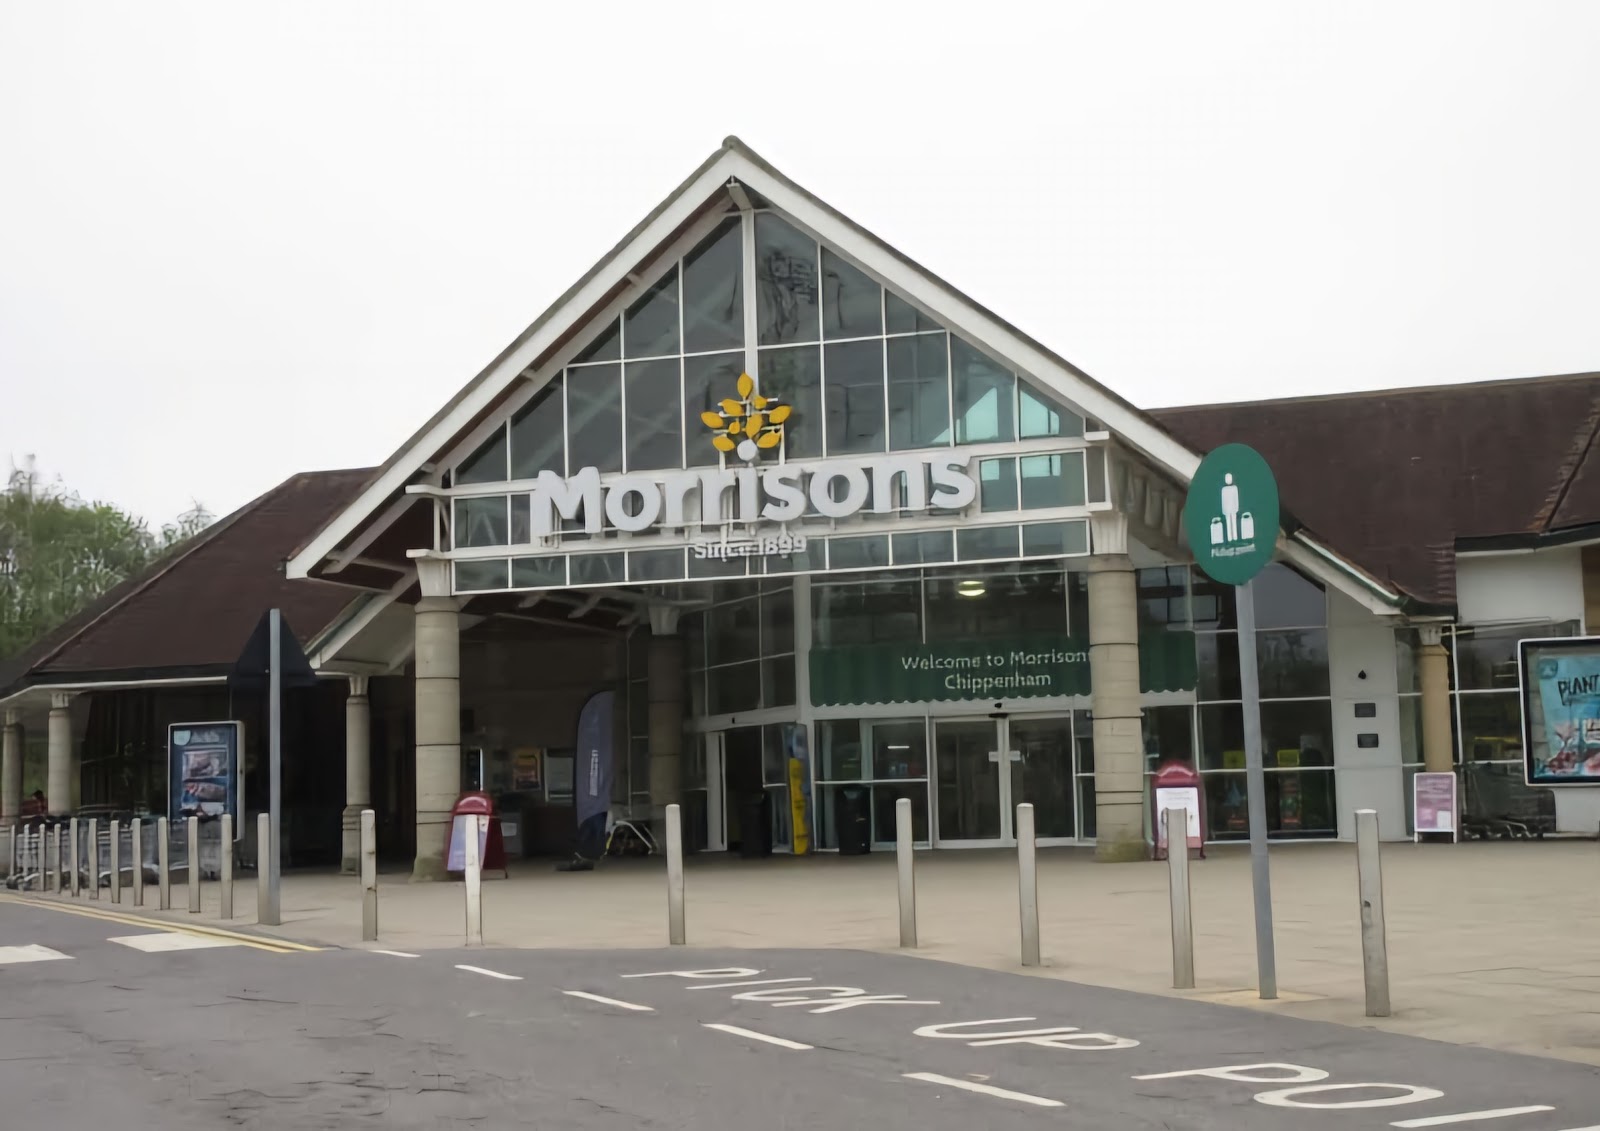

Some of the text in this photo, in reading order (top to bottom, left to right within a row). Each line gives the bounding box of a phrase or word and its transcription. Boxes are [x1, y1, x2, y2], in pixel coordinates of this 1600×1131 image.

[530, 454, 977, 537] Morrisons
[901, 649, 1091, 670] Welcome to Morrison
[944, 673, 1052, 694] Chippenham
[620, 966, 941, 1014] PICK
[912, 1017, 1141, 1051] UP
